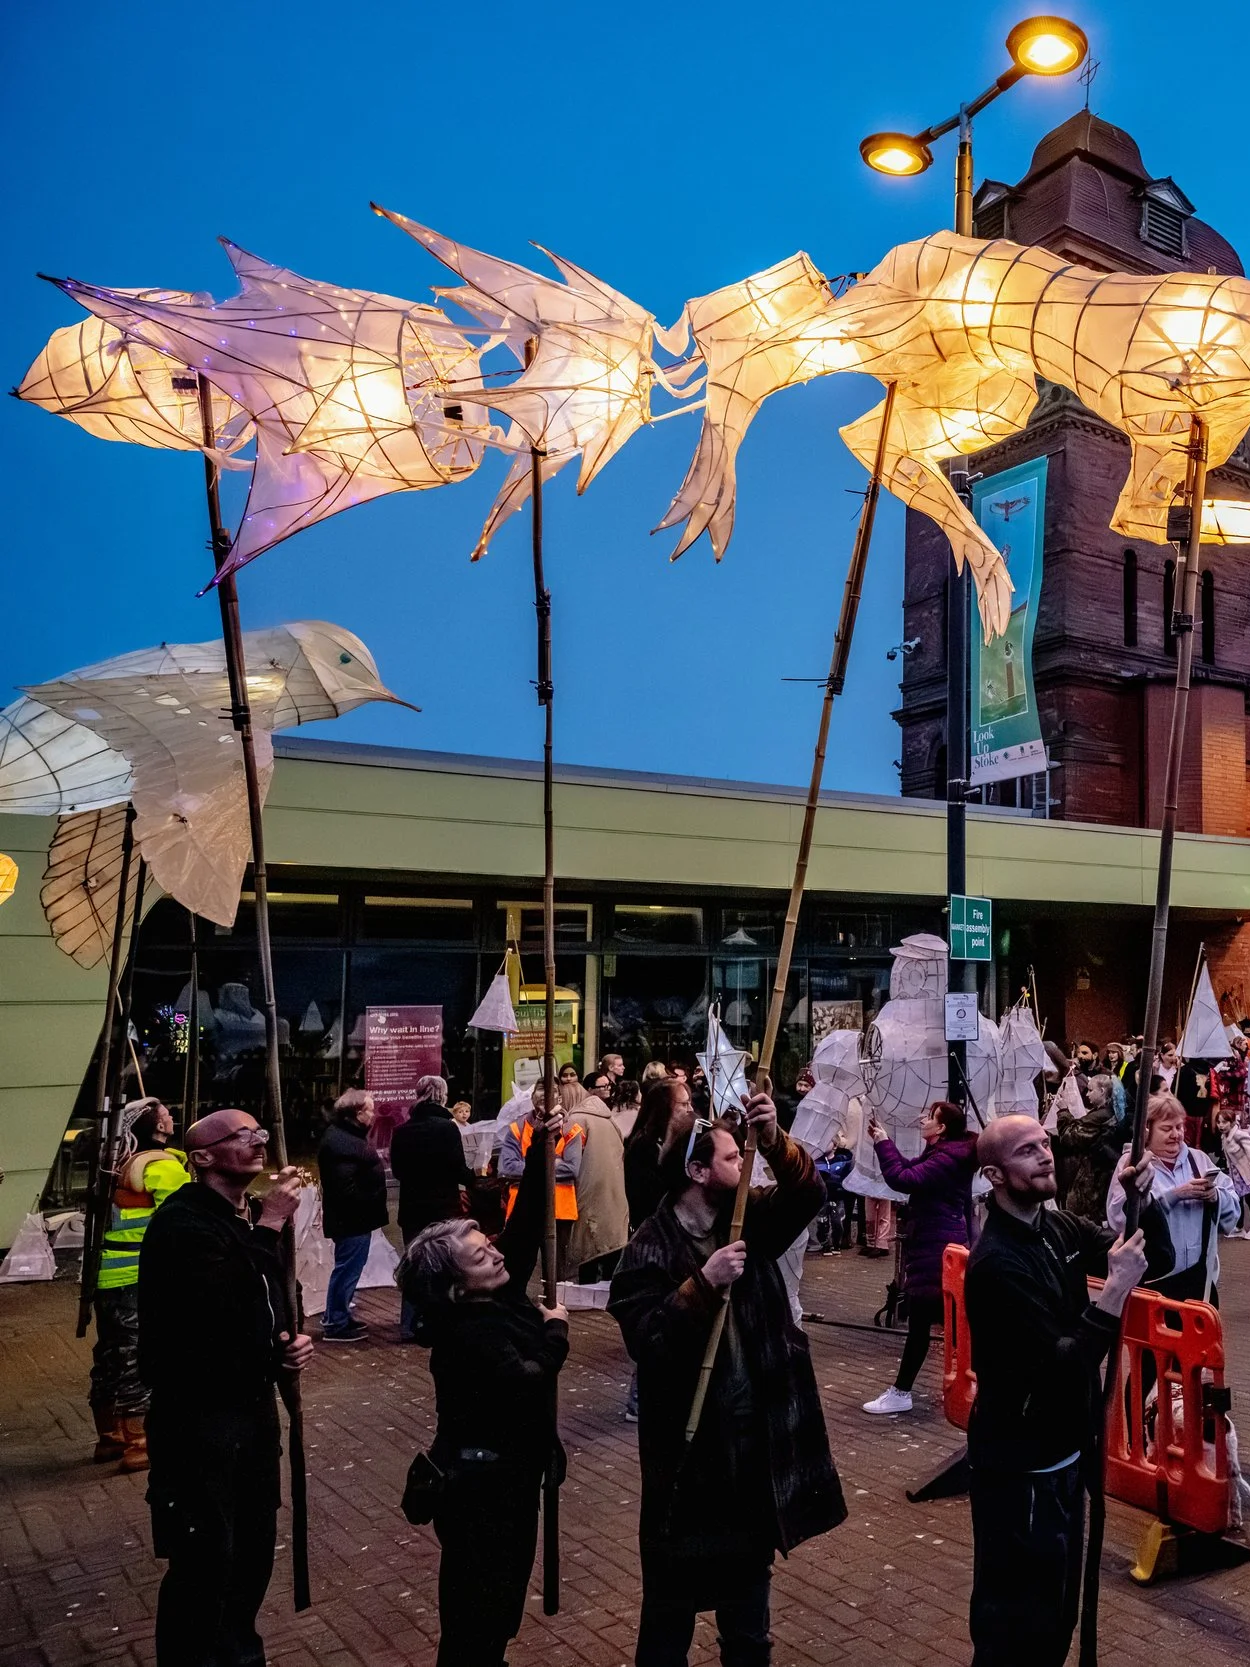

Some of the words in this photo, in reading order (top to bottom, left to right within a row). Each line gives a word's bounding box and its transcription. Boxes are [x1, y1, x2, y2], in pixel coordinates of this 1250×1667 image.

[973, 726, 995, 744] Look
[976, 741, 990, 757] Up
[974, 752, 999, 769] Stoke
[972, 909, 984, 920] Fire
[966, 923, 990, 937] assembly
[971, 937, 985, 949] point
[369, 1026, 388, 1035] Why
[390, 1026, 408, 1034] wait
[409, 1025, 418, 1033] in
[419, 1025, 440, 1033] line?
